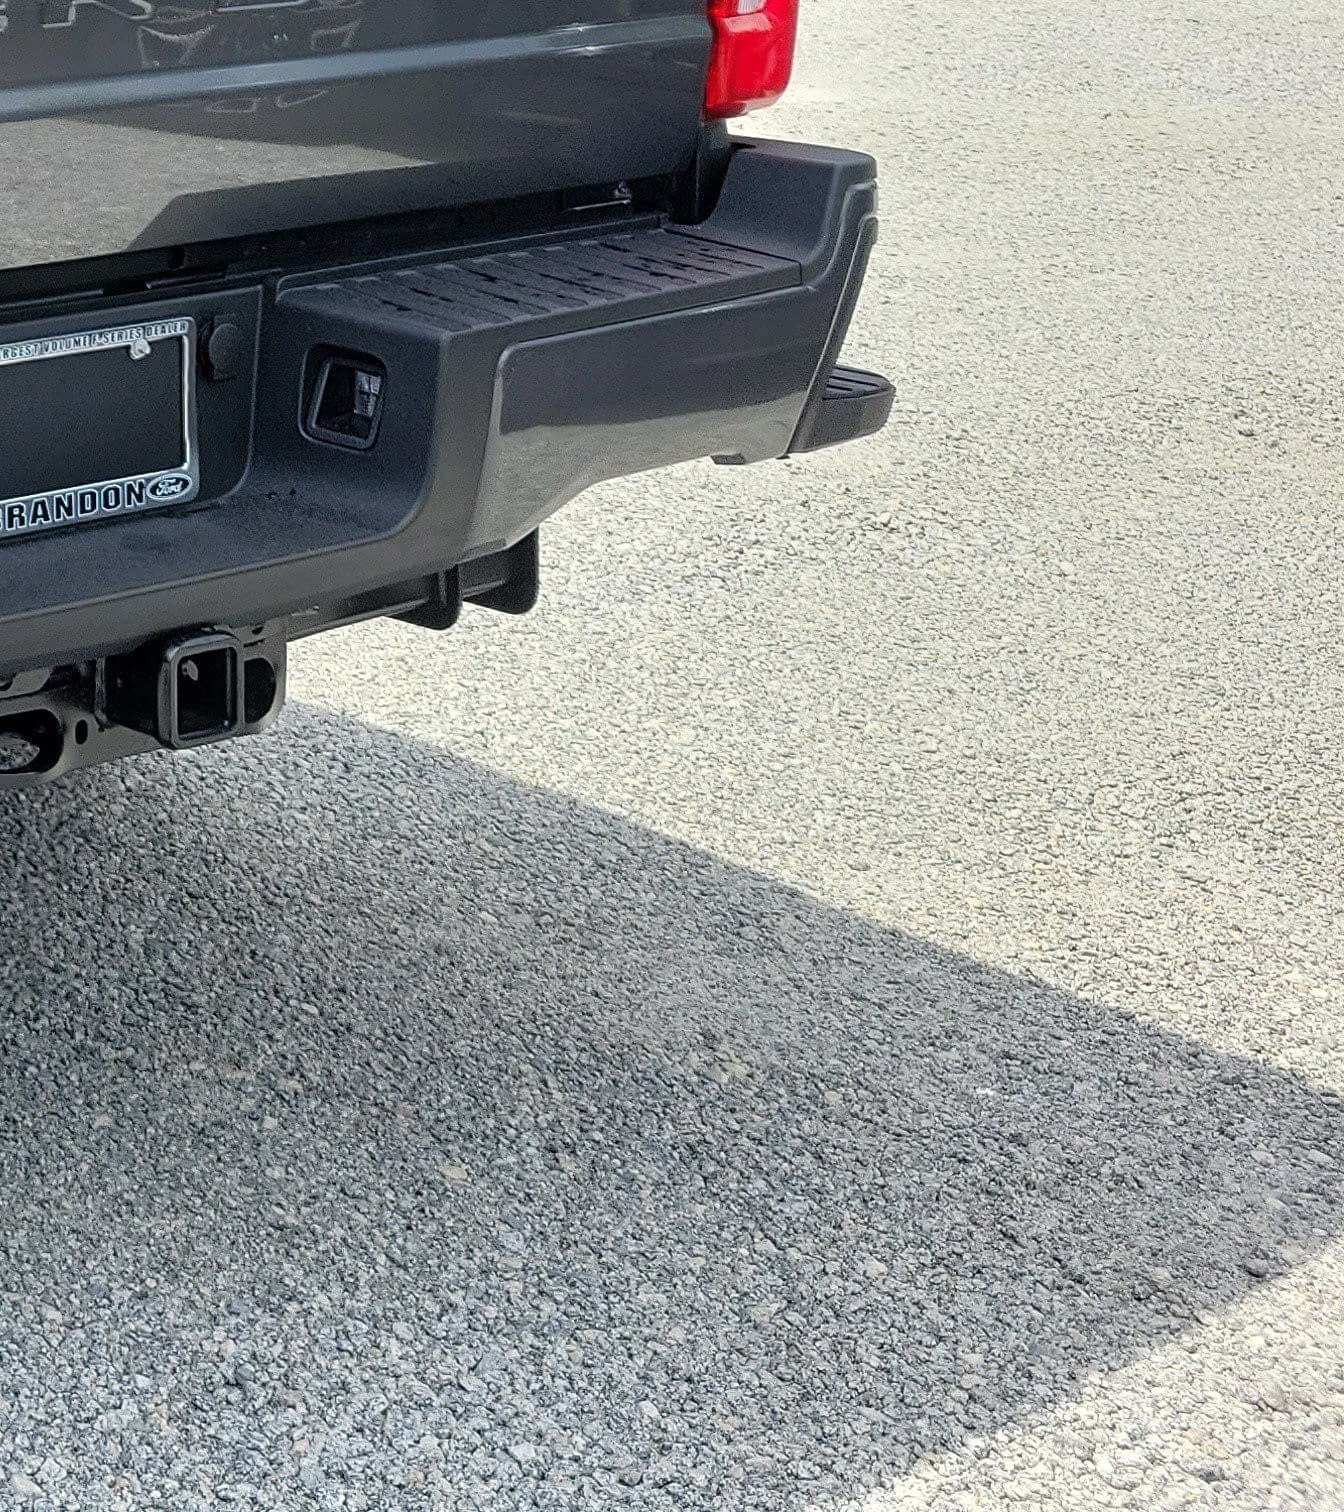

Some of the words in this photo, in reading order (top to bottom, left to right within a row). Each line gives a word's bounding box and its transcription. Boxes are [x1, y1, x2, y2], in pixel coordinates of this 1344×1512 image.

[43, 337, 87, 353] VOLUME
[145, 321, 188, 337] DEALER
[156, 479, 184, 495] Ford
